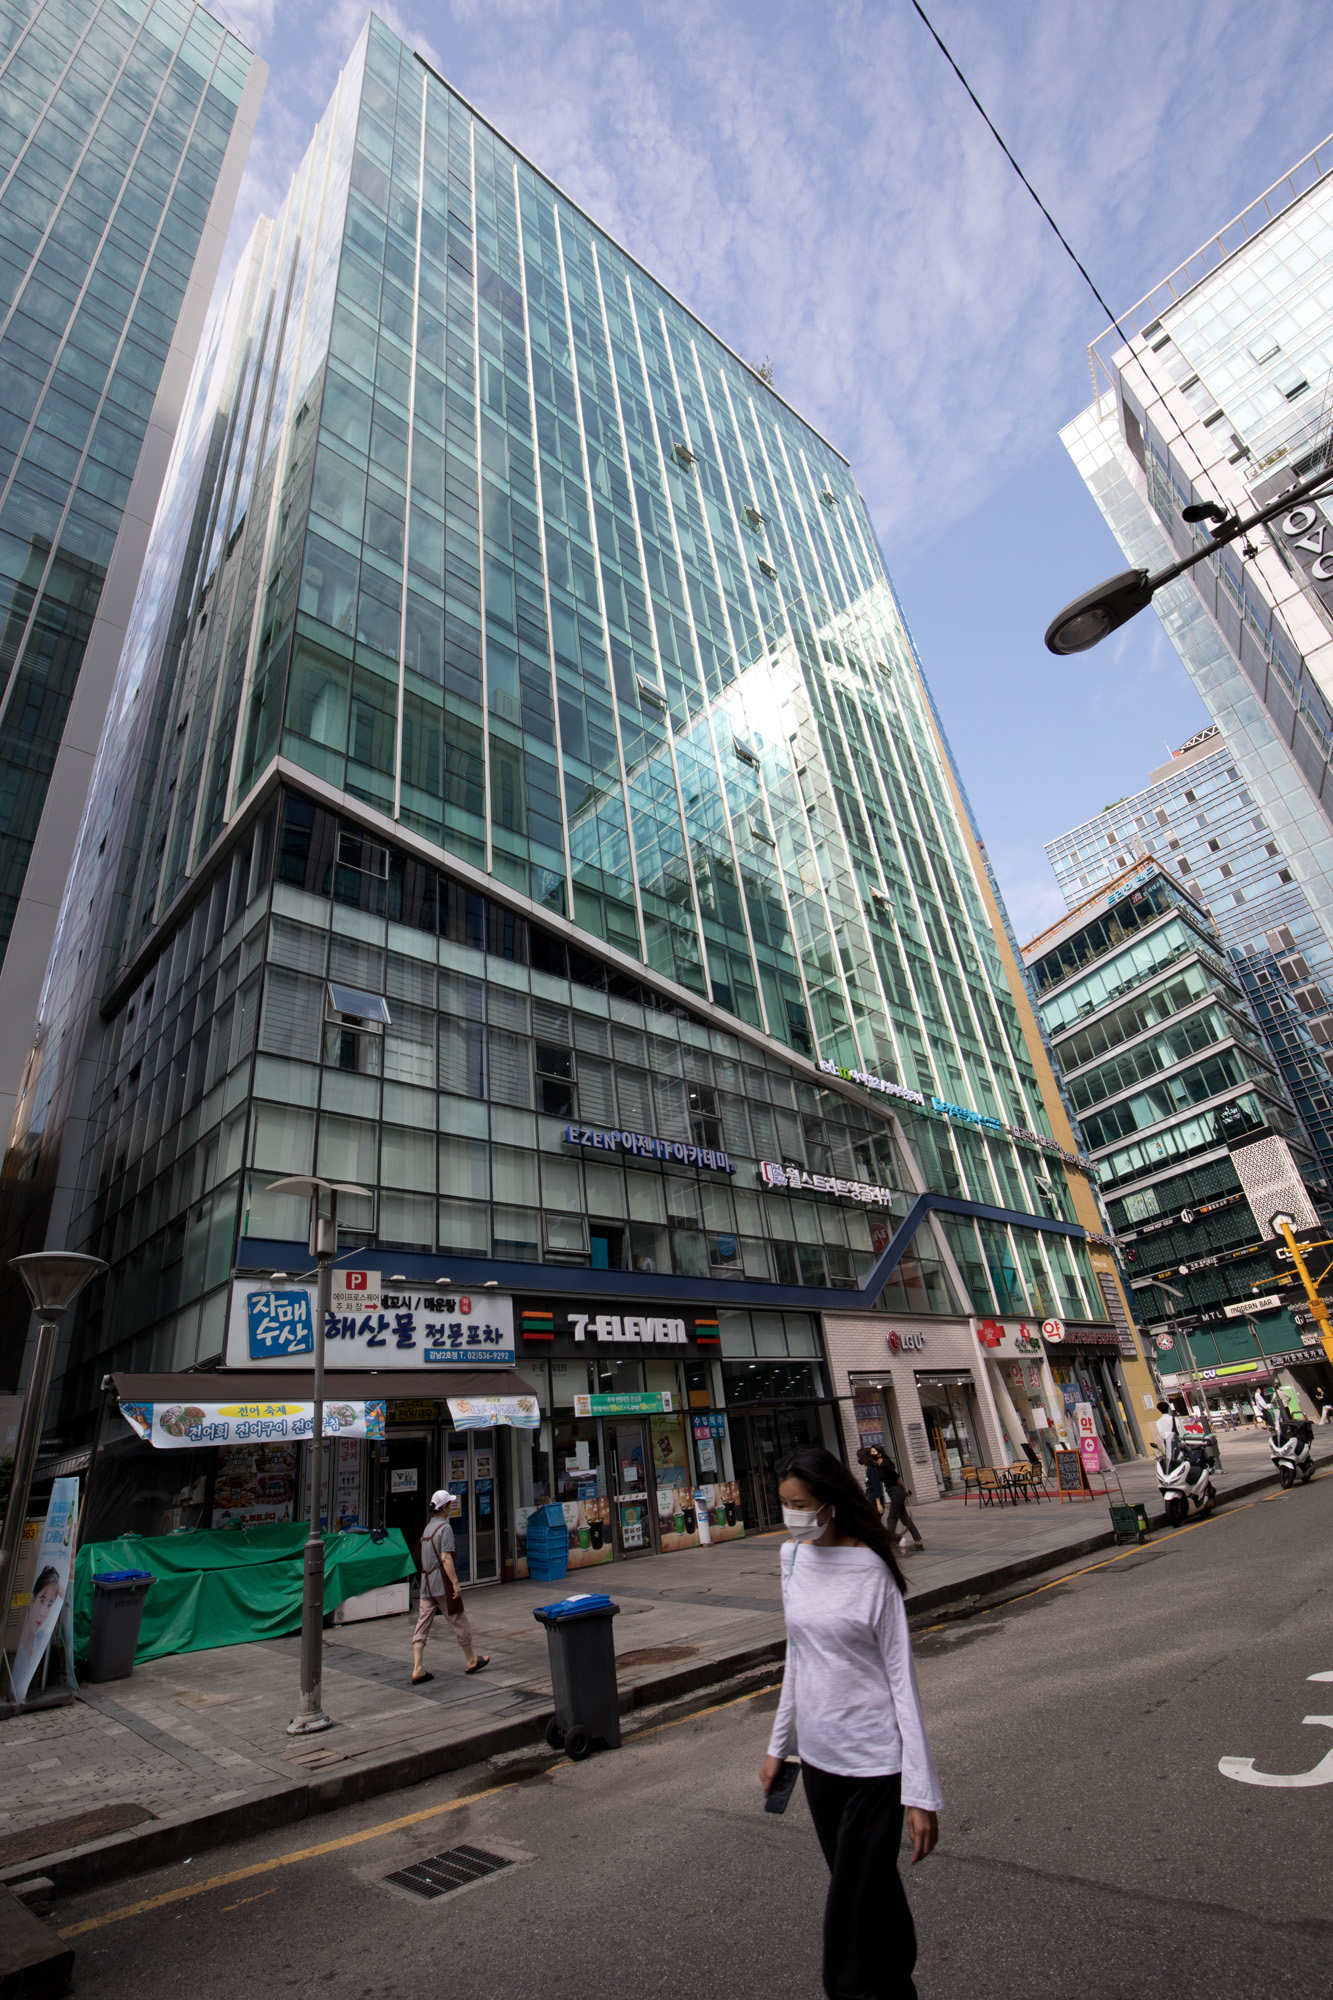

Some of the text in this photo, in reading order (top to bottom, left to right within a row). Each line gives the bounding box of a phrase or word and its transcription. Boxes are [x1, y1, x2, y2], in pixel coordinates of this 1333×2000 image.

[568, 1126, 616, 1151] EZEN
[351, 1273, 362, 1288] P
[333, 1293, 380, 1301] 에이프로스퀘어
[1259, 1299, 1273, 1308] BAR
[252, 1294, 307, 1322] 자매
[424, 1296, 457, 1313] 매운탕
[1201, 1310, 1223, 1322] MTL
[256, 1317, 308, 1352] 수산
[325, 1312, 503, 1349] 해산물 전문포차
[984, 1327, 996, 1341] 愛
[1043, 1320, 1062, 1340] 약
[1096, 1333, 1120, 1345] COFFEE
[429, 1351, 458, 1361] 강남2호점
[467, 1351, 509, 1360] 02)536-9292
[1011, 1364, 1027, 1390] 약
[1203, 1369, 1216, 1378] CU
[237, 1404, 287, 1417] 전어 축제
[694, 1415, 725, 1426] 수입맥주
[1081, 1417, 1093, 1434] 약
[188, 1422, 229, 1442] 전어회
[235, 1421, 288, 1439] 전어구이
[341, 1440, 357, 1450] 먹튀
[341, 1451, 357, 1461] 금지
[45, 1530, 65, 1543] 다음날
